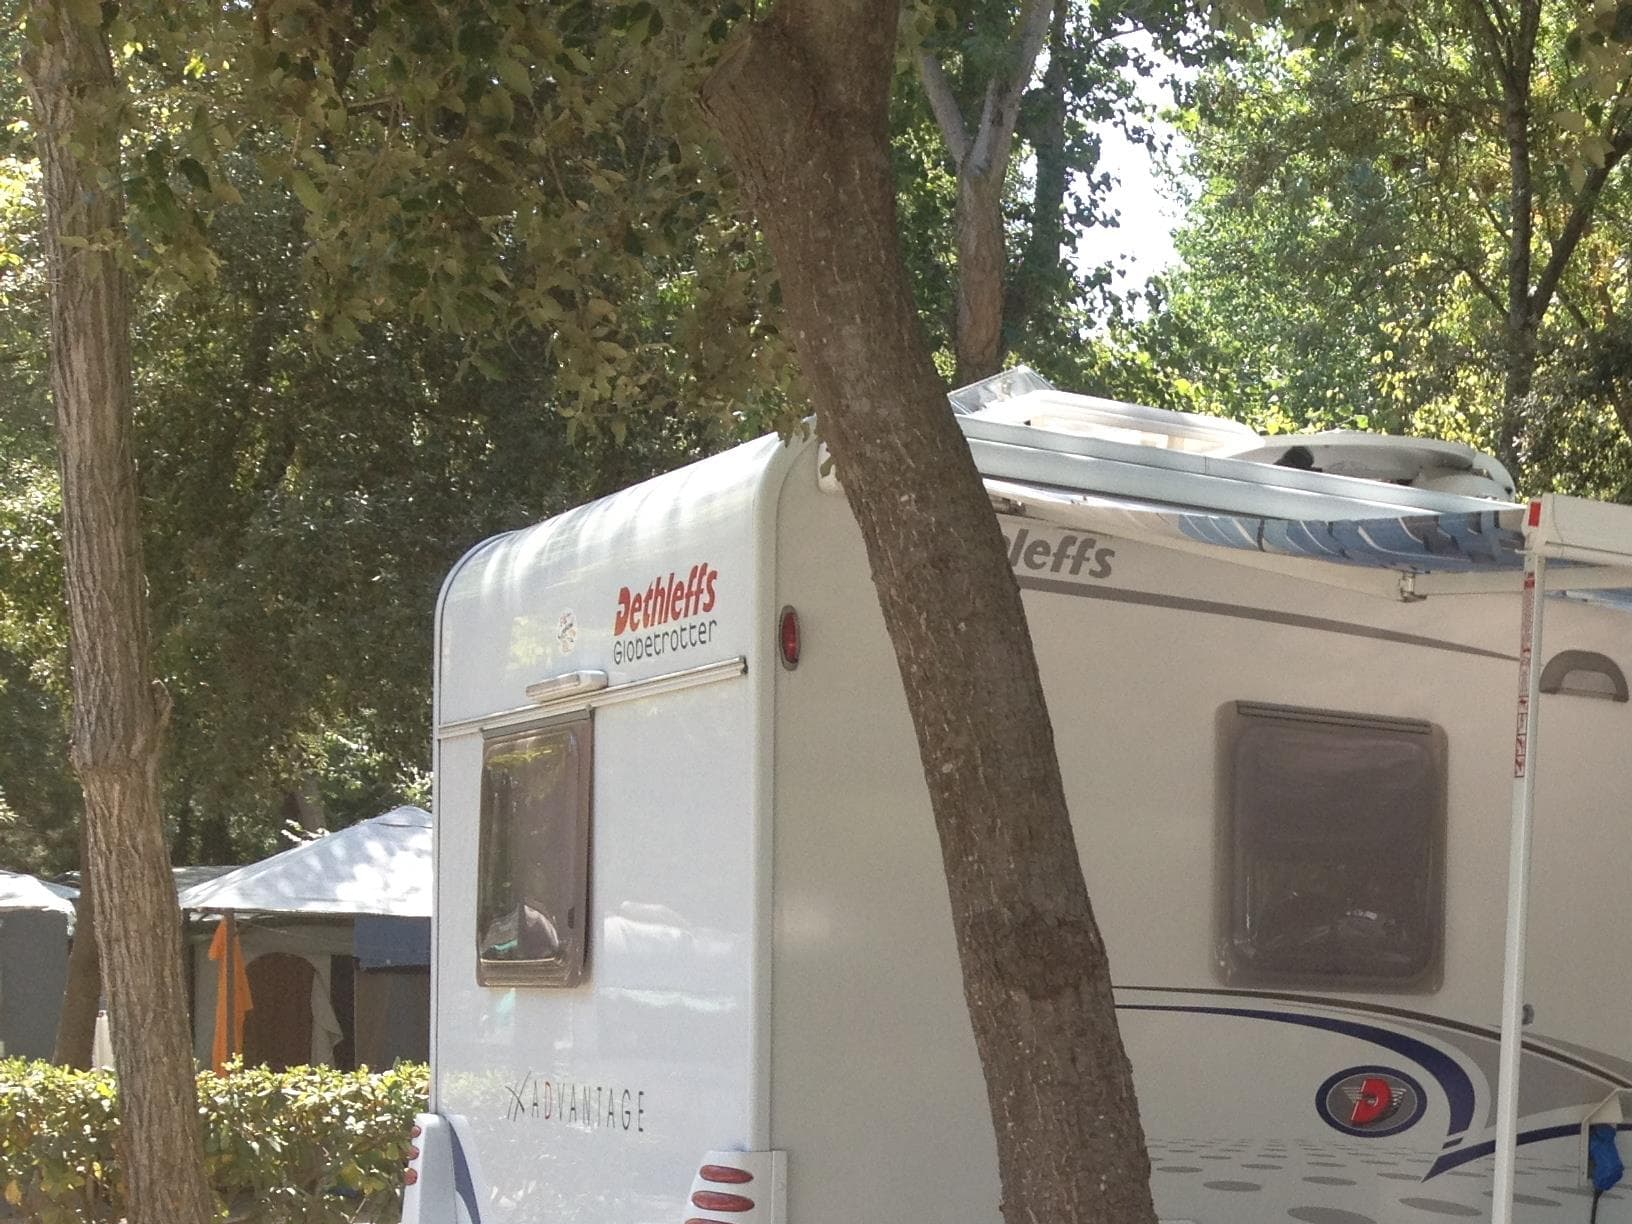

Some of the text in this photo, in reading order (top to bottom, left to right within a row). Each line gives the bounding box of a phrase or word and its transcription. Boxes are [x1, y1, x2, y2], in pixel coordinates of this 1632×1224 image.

[1002, 528, 1115, 579] leffs
[613, 562, 718, 636] Dethleffs
[613, 619, 717, 665] Globetrotter
